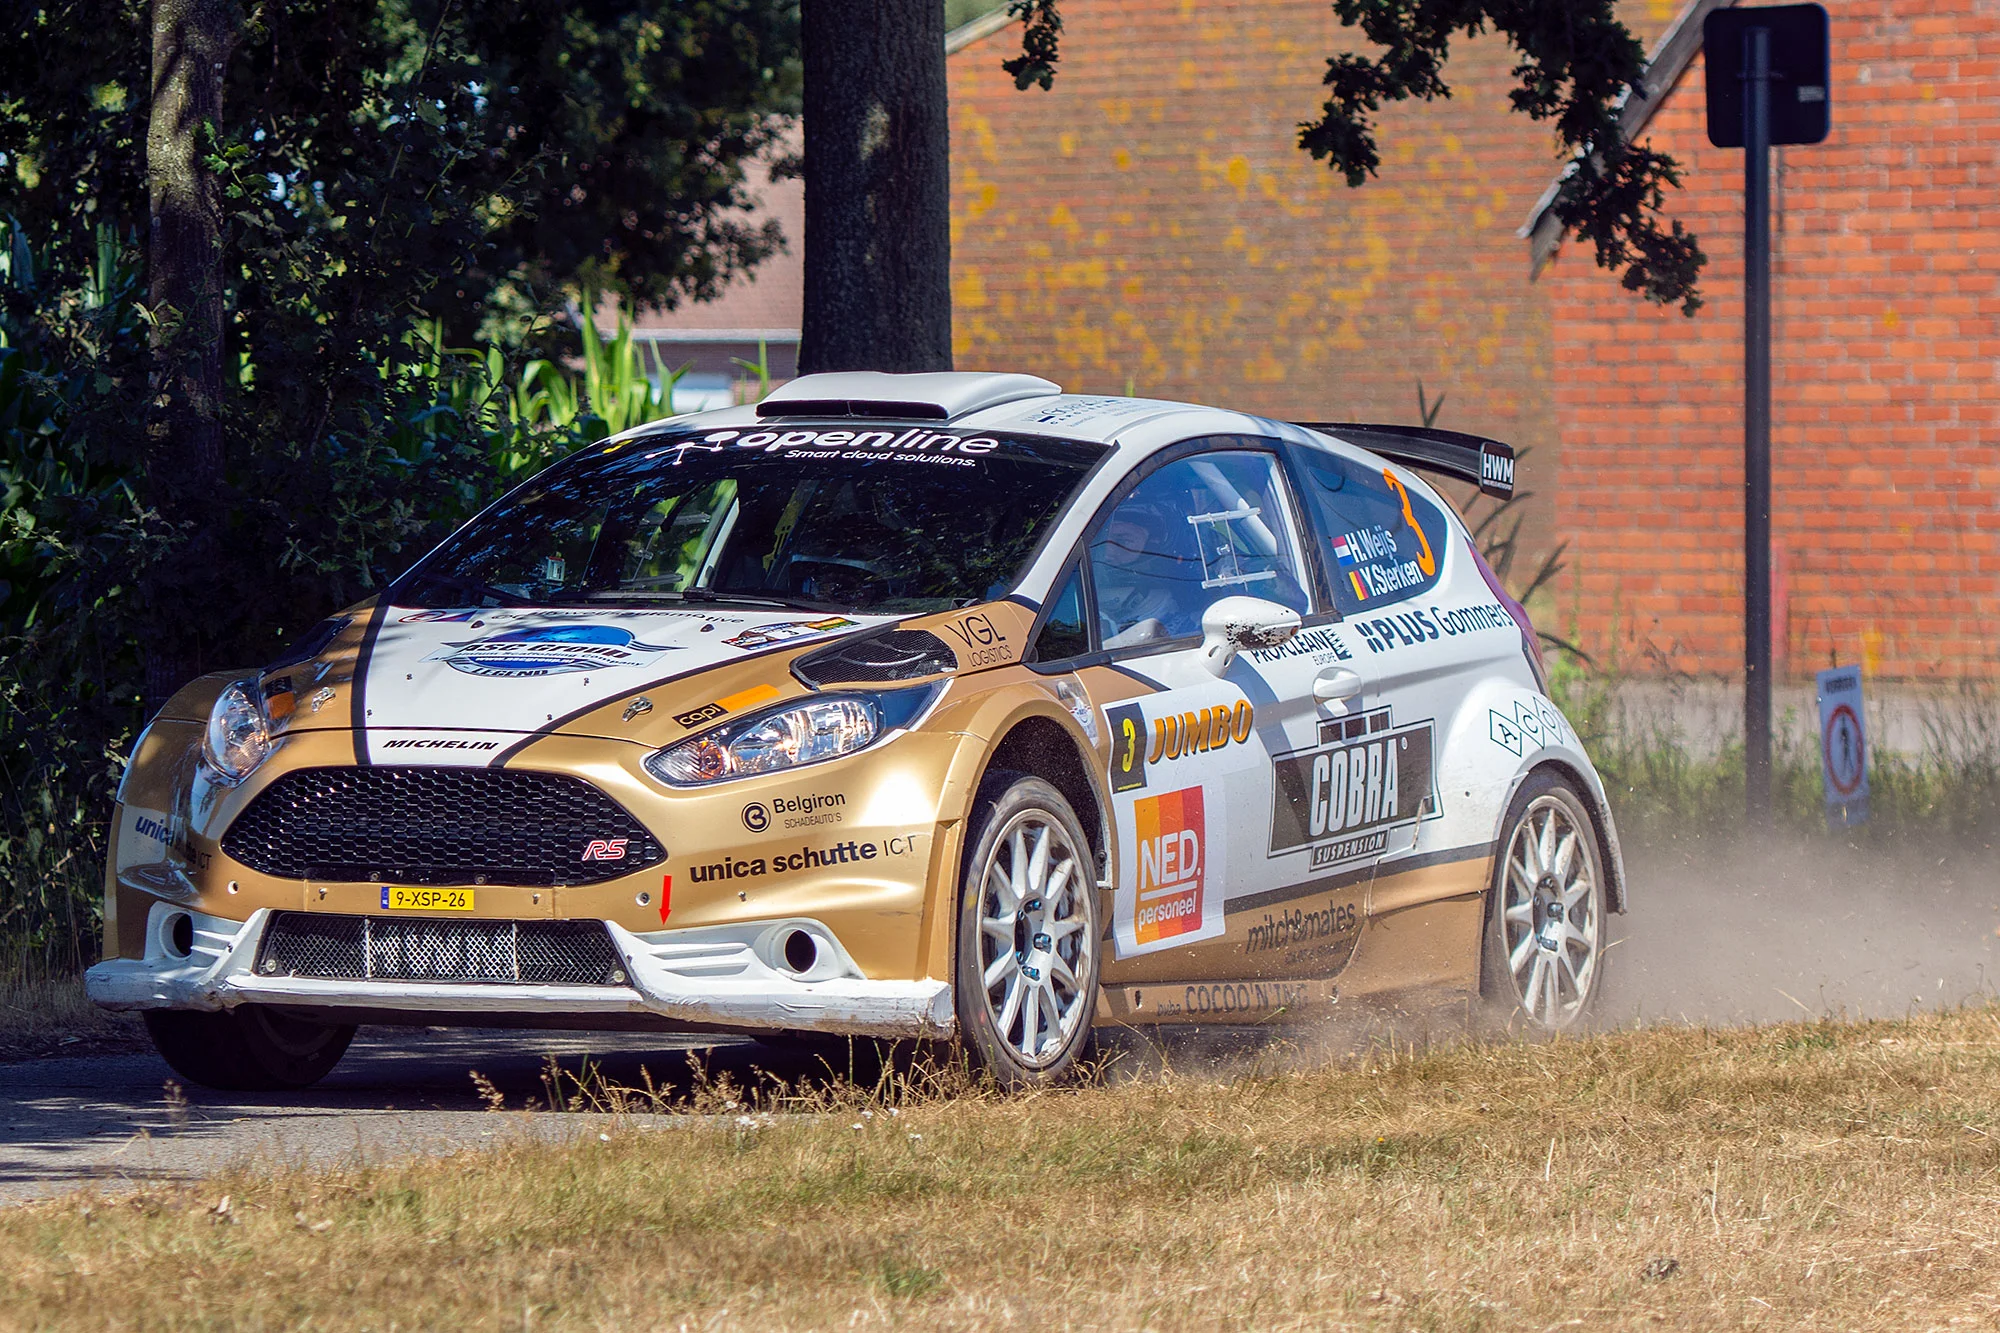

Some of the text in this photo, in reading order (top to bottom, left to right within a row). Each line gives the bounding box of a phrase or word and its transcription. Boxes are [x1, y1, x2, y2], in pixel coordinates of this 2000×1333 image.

[736, 428, 999, 453] openline
[784, 449, 976, 467] Smart cloud solutions.
[1482, 453, 1514, 484] HWM
[1383, 467, 1436, 577] 3
[1360, 559, 1425, 596] Y.Sterken
[944, 613, 1006, 648] VGL
[1371, 603, 1514, 649] PLUS Gommers
[527, 643, 632, 659] Group
[967, 645, 1012, 667] LOGISTICS
[1312, 651, 1338, 666] EUROPE
[678, 703, 718, 727] capi
[383, 738, 499, 752] MICHELIN
[1122, 717, 1136, 773] 3
[1148, 699, 1254, 765] JUMBO
[772, 792, 846, 814] Belgiron
[1310, 738, 1399, 837] COBRA
[784, 812, 842, 829] SCHADEAUTO'S
[690, 835, 916, 883] unica schutte ICT
[1139, 829, 1201, 890] NED.
[1315, 832, 1385, 864] SUSPENSION
[396, 891, 466, 907] 9-XSP-26
[1138, 891, 1196, 931] personeel
[1245, 900, 1355, 955] mitch&mates
